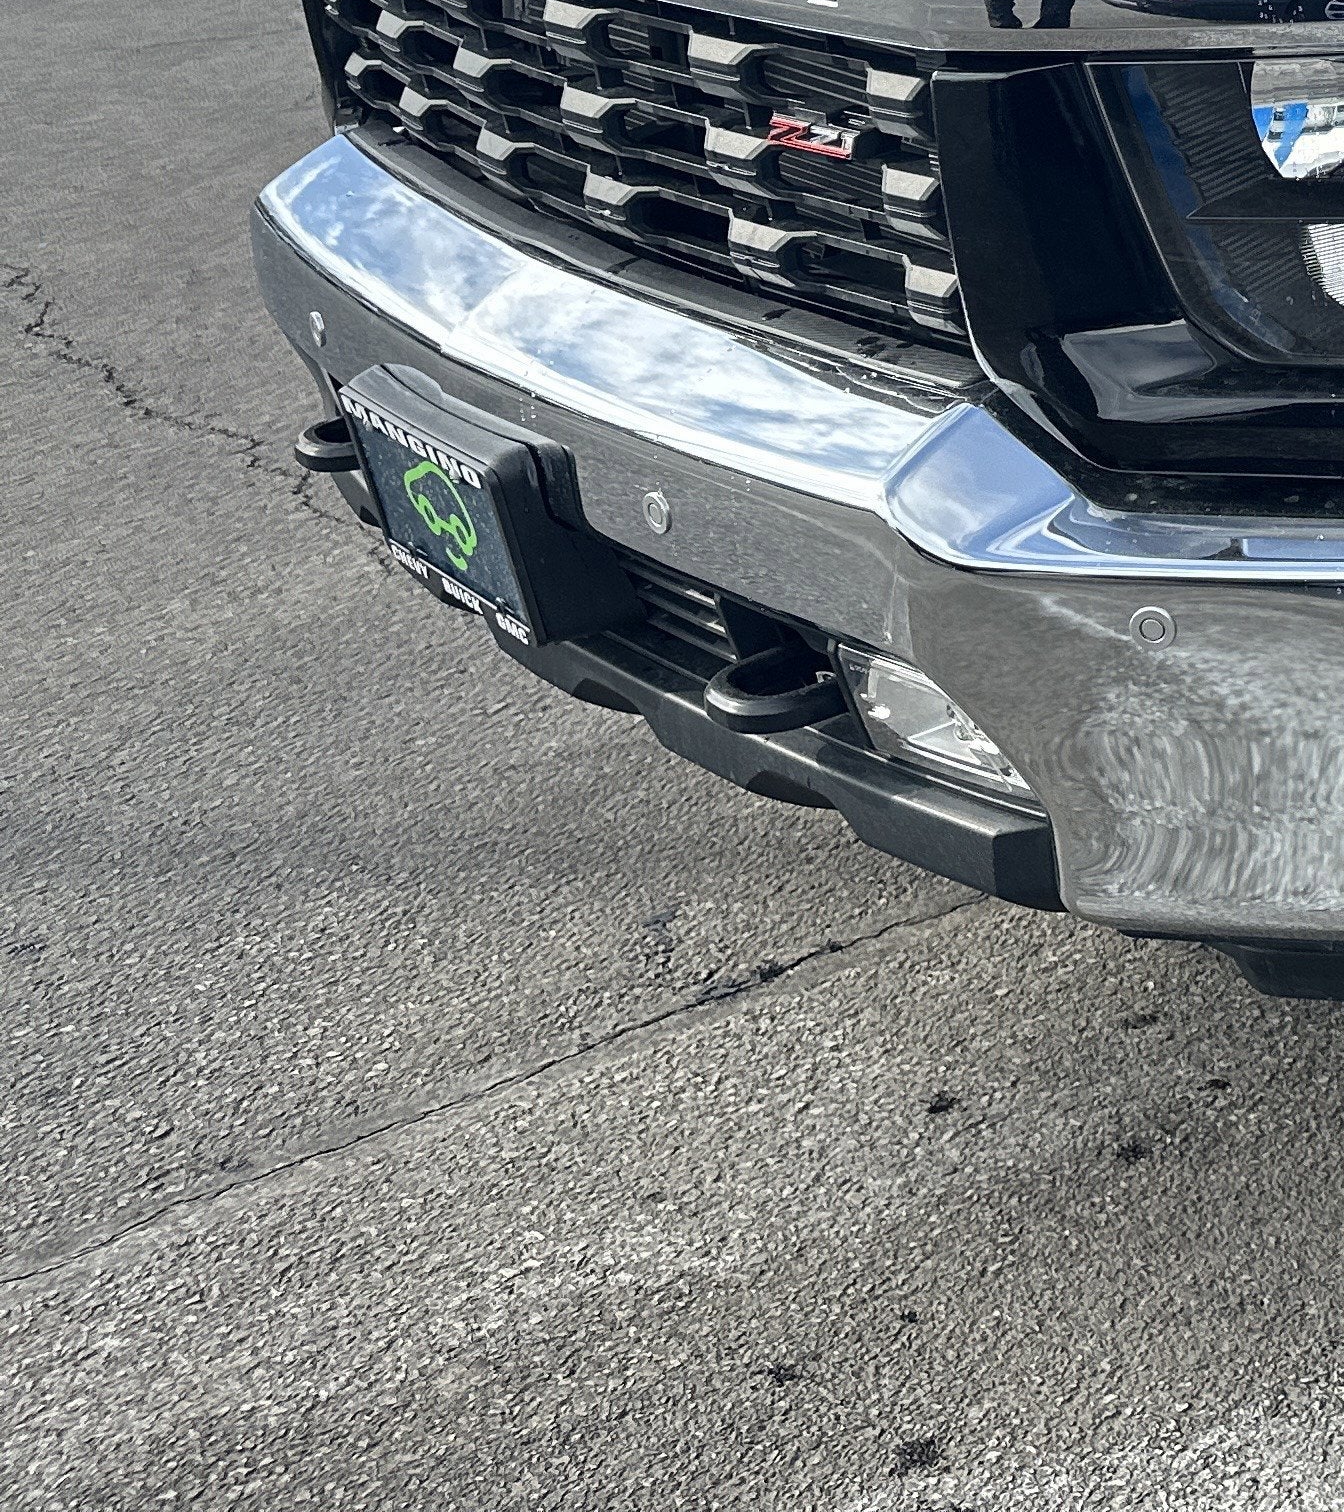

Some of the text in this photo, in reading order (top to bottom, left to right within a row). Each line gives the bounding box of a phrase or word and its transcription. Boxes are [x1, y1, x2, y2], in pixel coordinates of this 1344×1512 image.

[768, 110, 861, 160] Z71
[340, 393, 483, 489] MANGINO
[390, 543, 530, 646] CHEVY BUICK GMC
